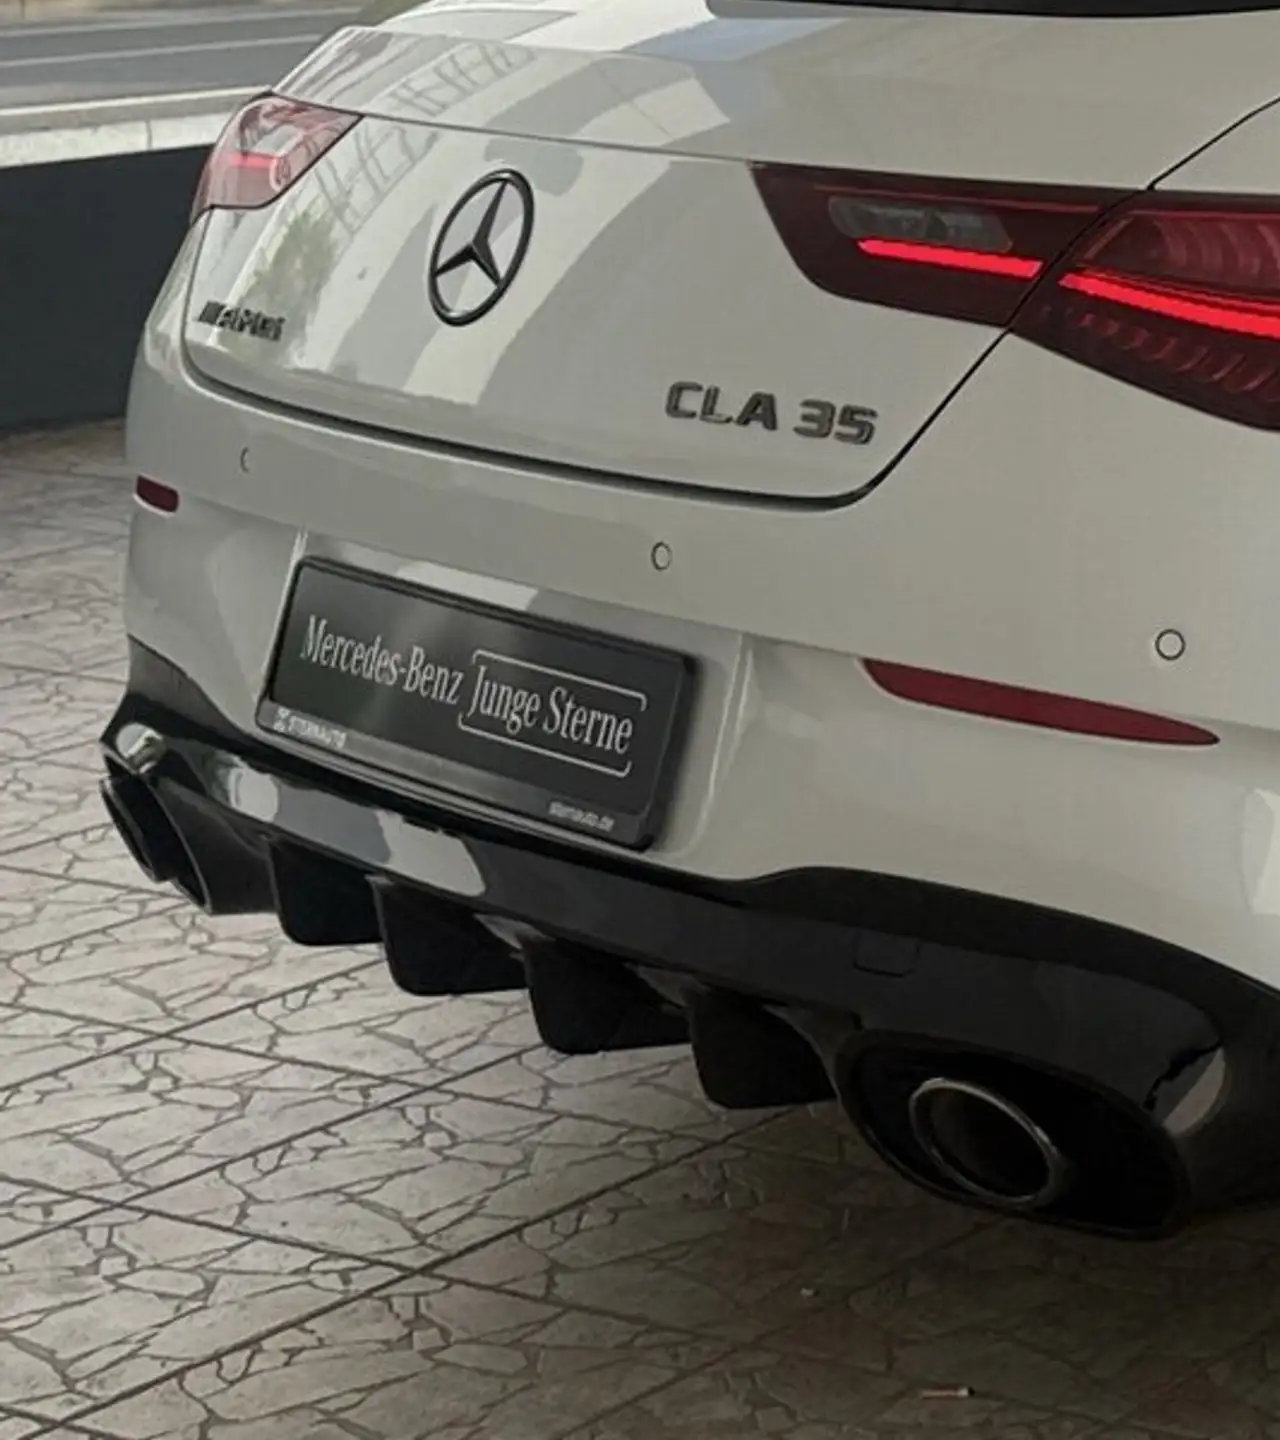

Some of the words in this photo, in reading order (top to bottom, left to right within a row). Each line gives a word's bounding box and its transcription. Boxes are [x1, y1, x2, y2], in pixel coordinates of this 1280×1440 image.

[665, 380, 779, 432] CLA
[792, 398, 879, 446] 35
[301, 614, 464, 705] Mercedes-Benz
[467, 665, 541, 736] Junge
[542, 685, 634, 756] Sterne
